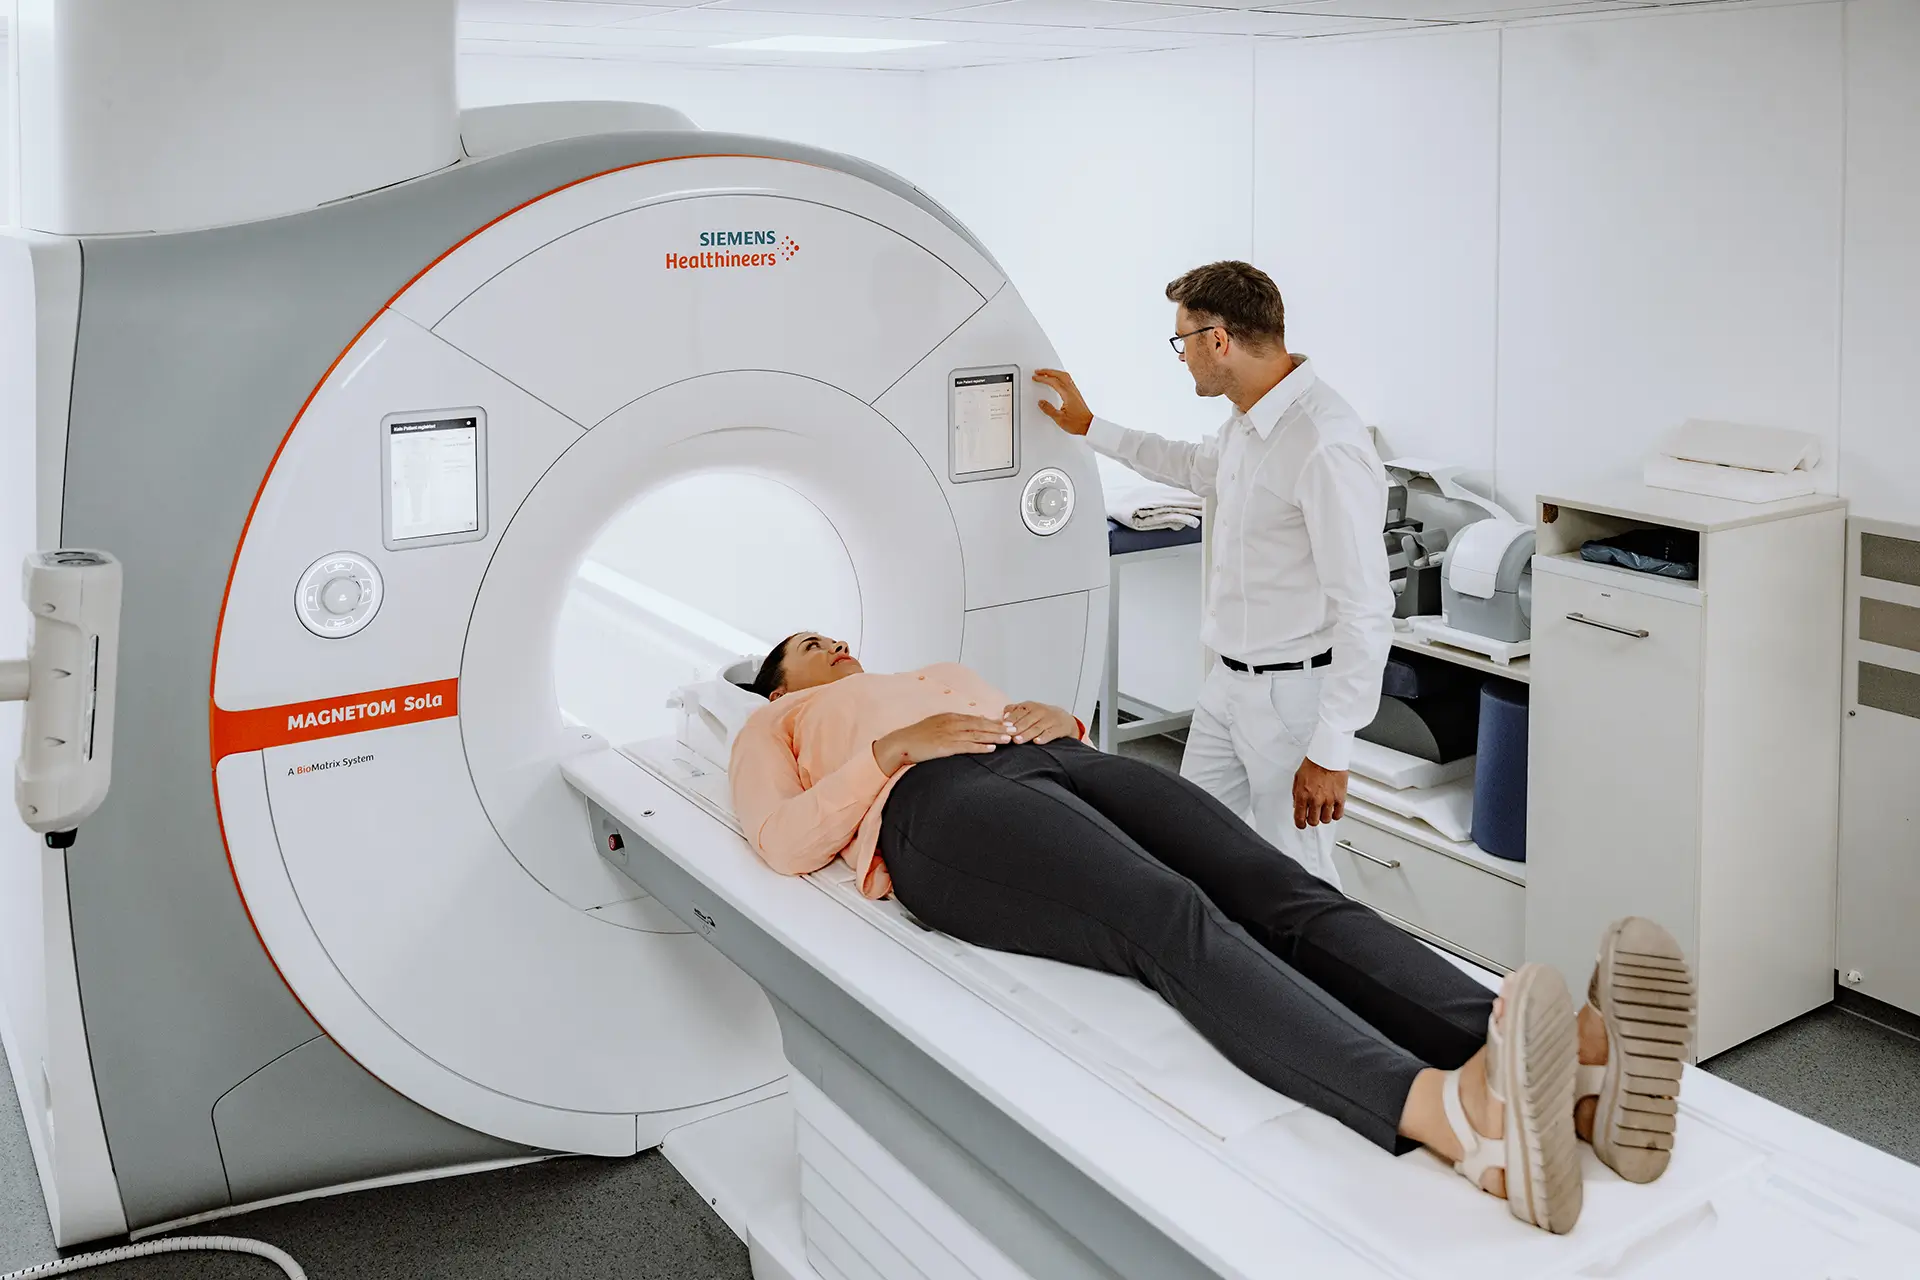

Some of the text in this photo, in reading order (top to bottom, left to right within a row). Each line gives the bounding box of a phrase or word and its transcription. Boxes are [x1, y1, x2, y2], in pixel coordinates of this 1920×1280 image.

[700, 230, 776, 246] SIEMENS
[665, 250, 777, 269] Healthineers
[287, 693, 443, 731] MAGNETOM Sola
[287, 754, 374, 776] A BioMatrix System
